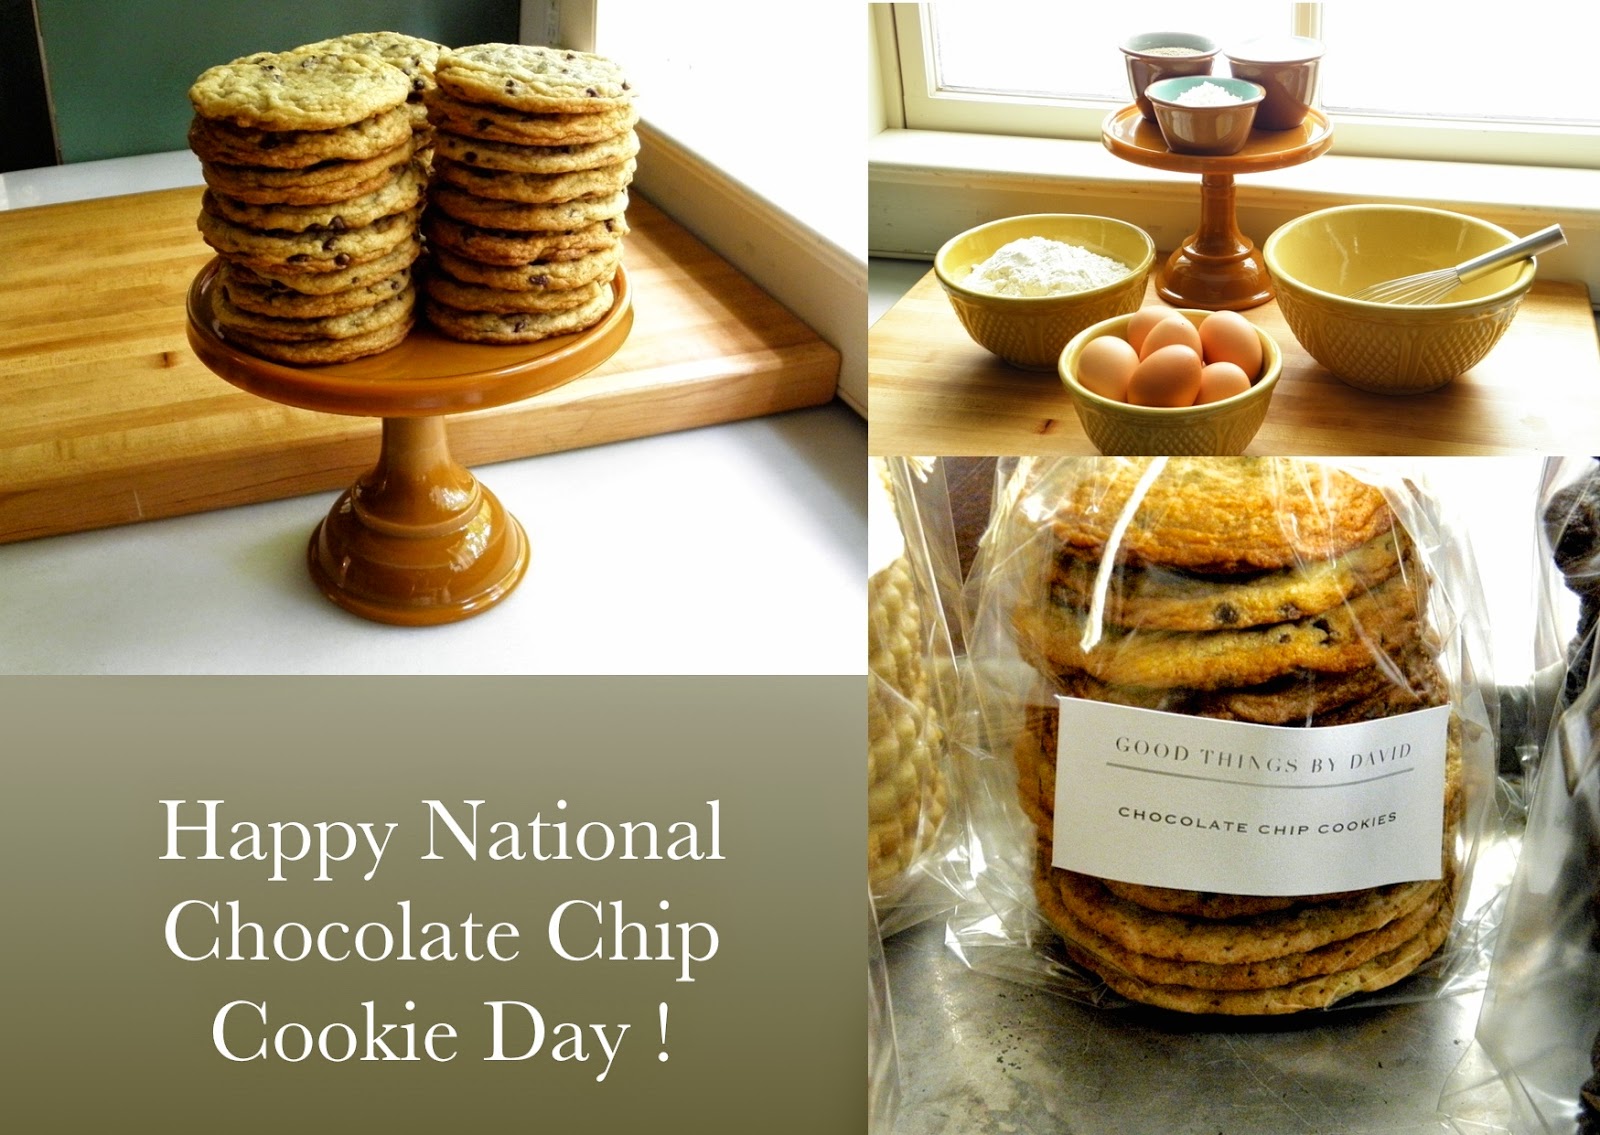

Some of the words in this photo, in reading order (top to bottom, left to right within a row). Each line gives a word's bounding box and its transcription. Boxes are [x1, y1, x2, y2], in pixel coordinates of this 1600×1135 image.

[1115, 736, 1190, 762] GOOD
[1199, 748, 1298, 774] THINGS
[1311, 757, 1337, 774] BY
[1350, 742, 1412, 771] DAVID
[1117, 806, 1249, 834] CHOCOLATE
[1258, 823, 1310, 836] CHIP
[1317, 811, 1398, 835] COOKIES
